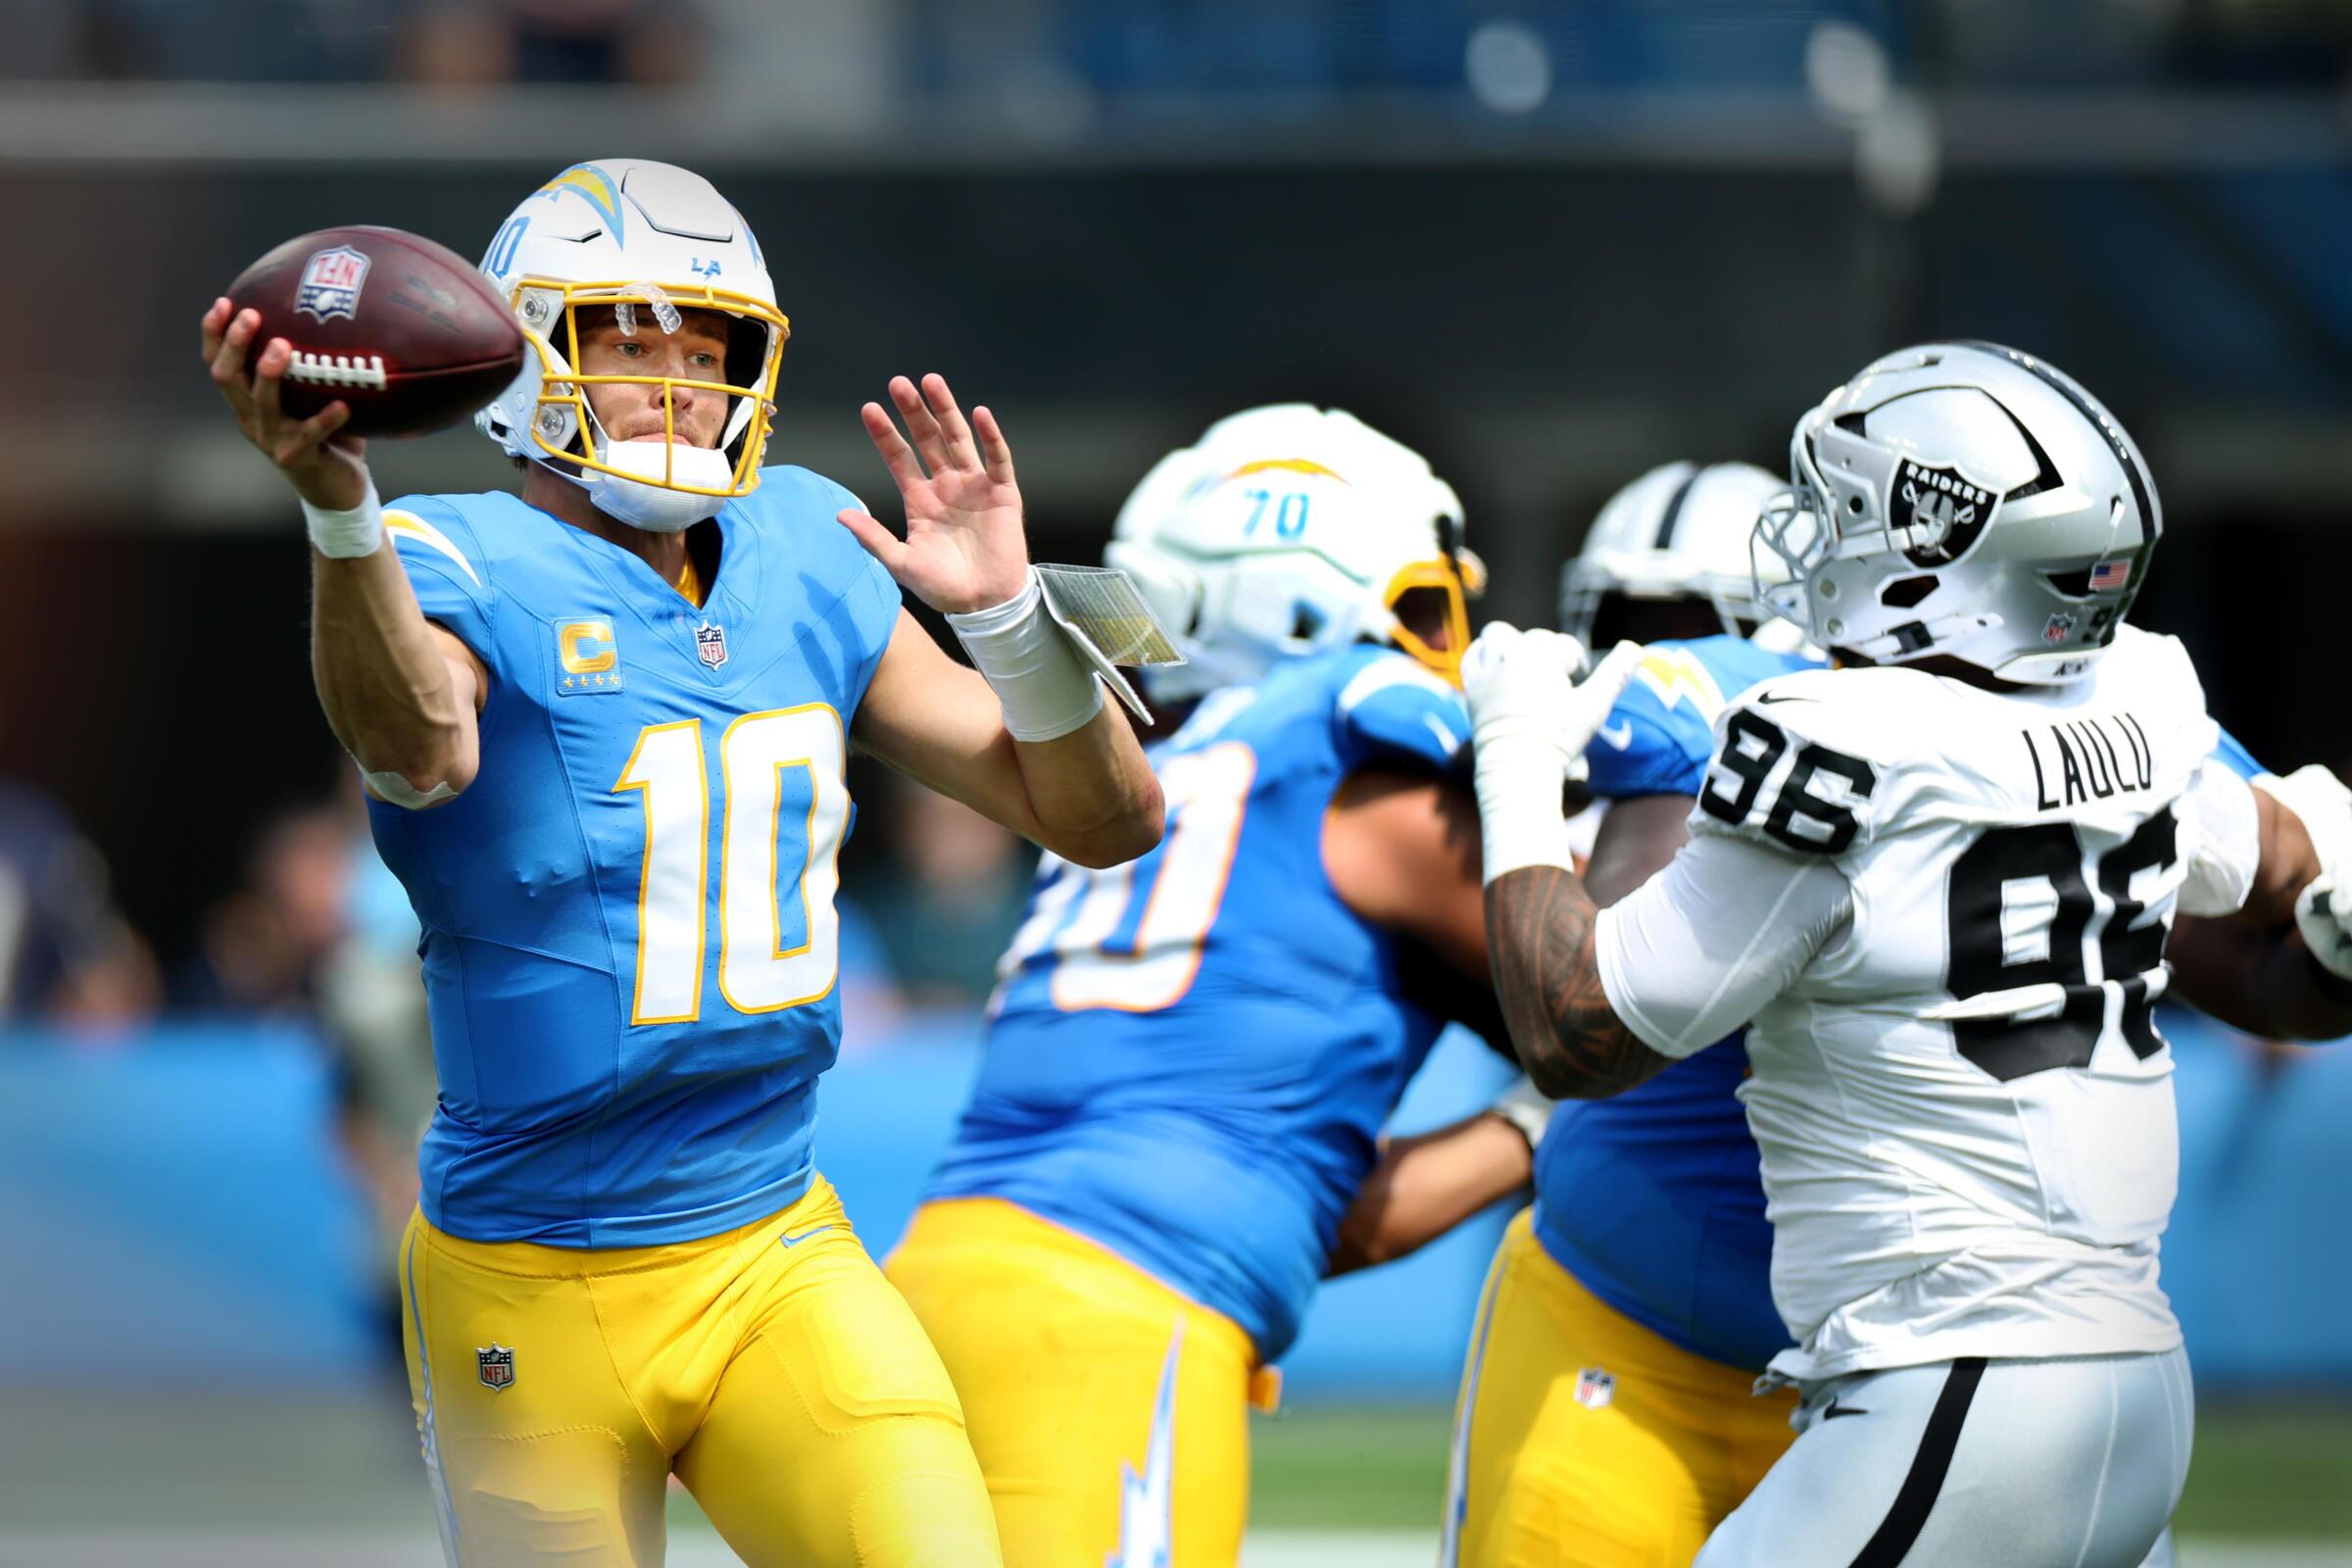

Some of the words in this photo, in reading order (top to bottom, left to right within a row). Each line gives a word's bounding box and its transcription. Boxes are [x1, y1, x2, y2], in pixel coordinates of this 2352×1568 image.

[691, 257, 722, 281] LA
[1906, 462, 1987, 506] RAIDERS
[1243, 488, 1310, 543] 70
[561, 621, 615, 675] C
[703, 643, 724, 661] NFL
[1700, 708, 1876, 855] 96
[2022, 712, 2153, 811] LAULU
[612, 703, 848, 1025] 10
[484, 1365, 511, 1383] NFL
